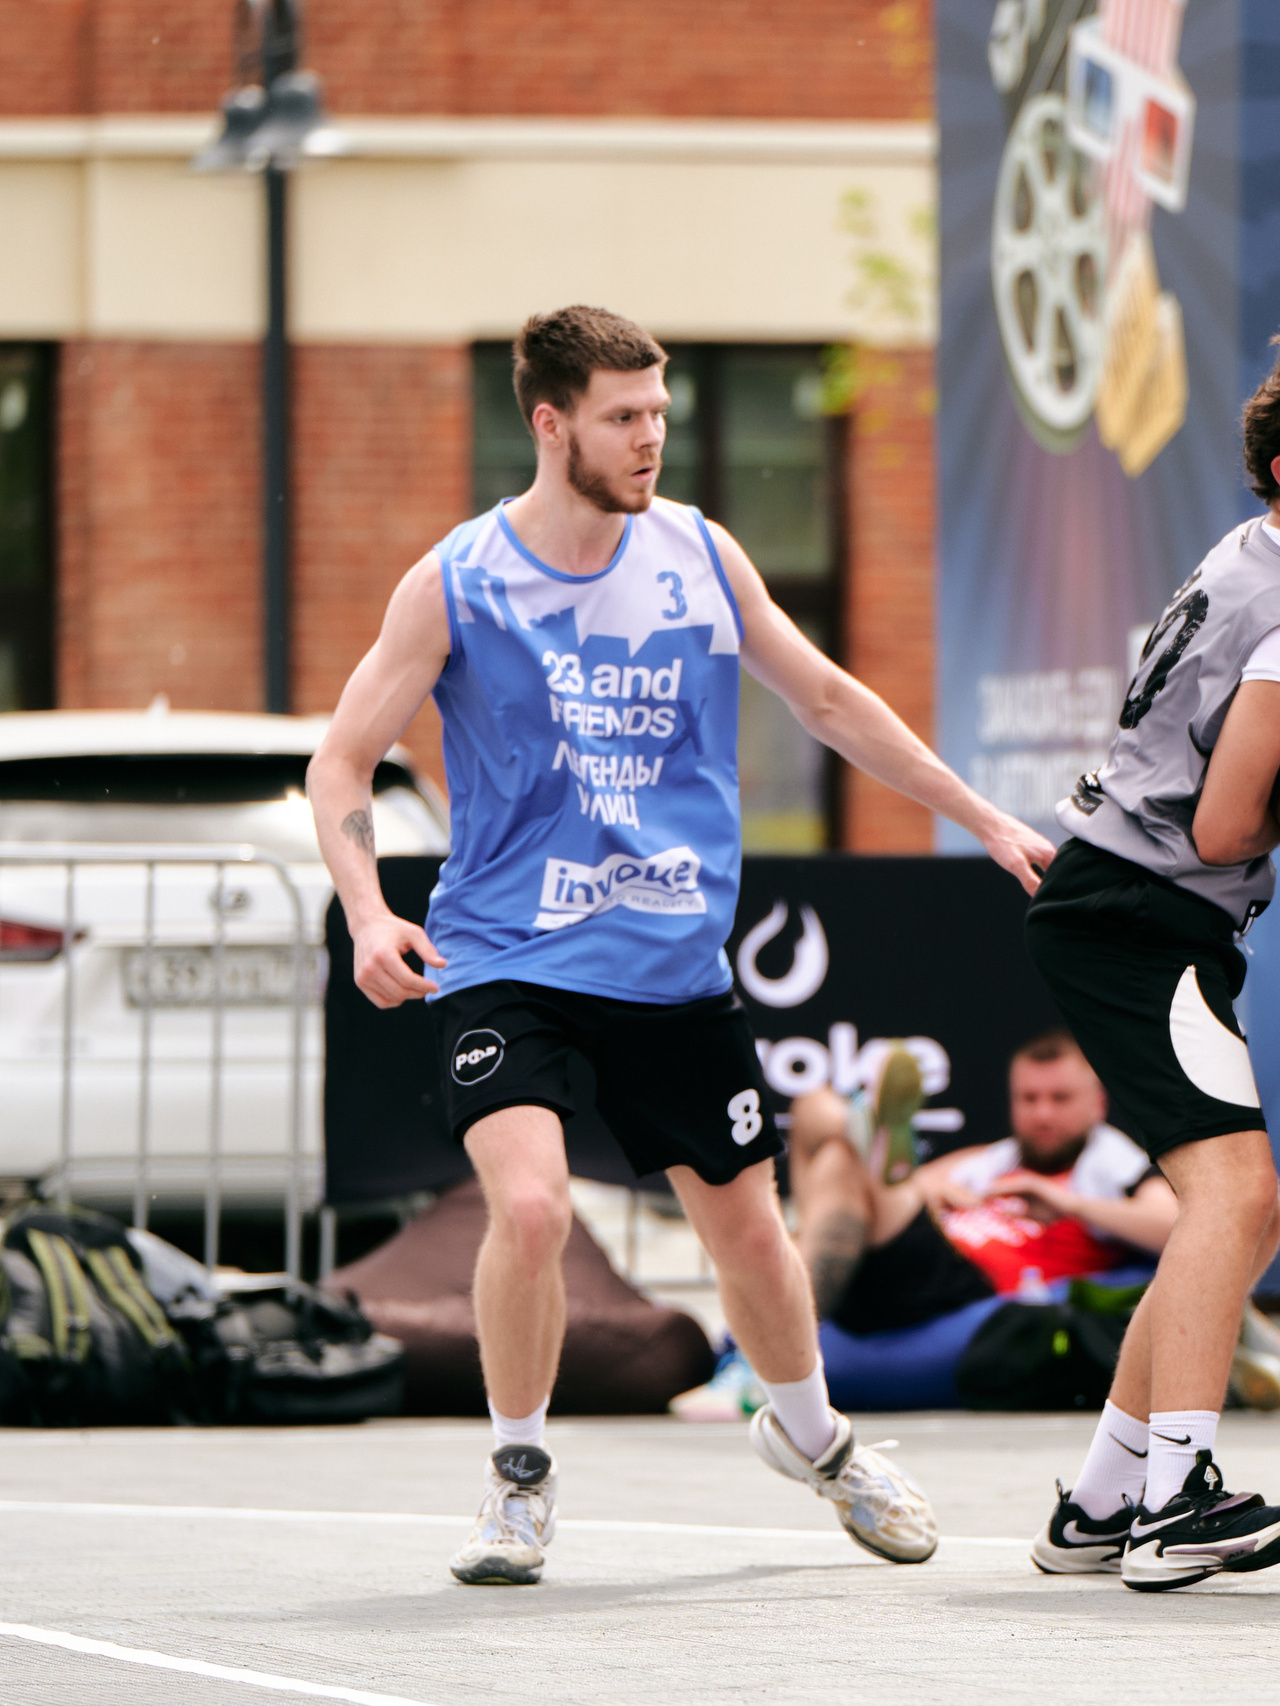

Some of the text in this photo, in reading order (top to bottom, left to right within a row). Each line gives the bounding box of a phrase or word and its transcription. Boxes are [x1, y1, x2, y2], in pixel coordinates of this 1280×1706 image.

[656, 569, 688, 621] 3
[541, 649, 682, 702] 23 and
[549, 692, 676, 740] FRIENDS
[551, 739, 665, 791] ЛЕГЕНДЫ
[577, 784, 641, 831] УЛИЦ
[554, 861, 692, 905] invoke
[727, 1088, 764, 1146] 8
